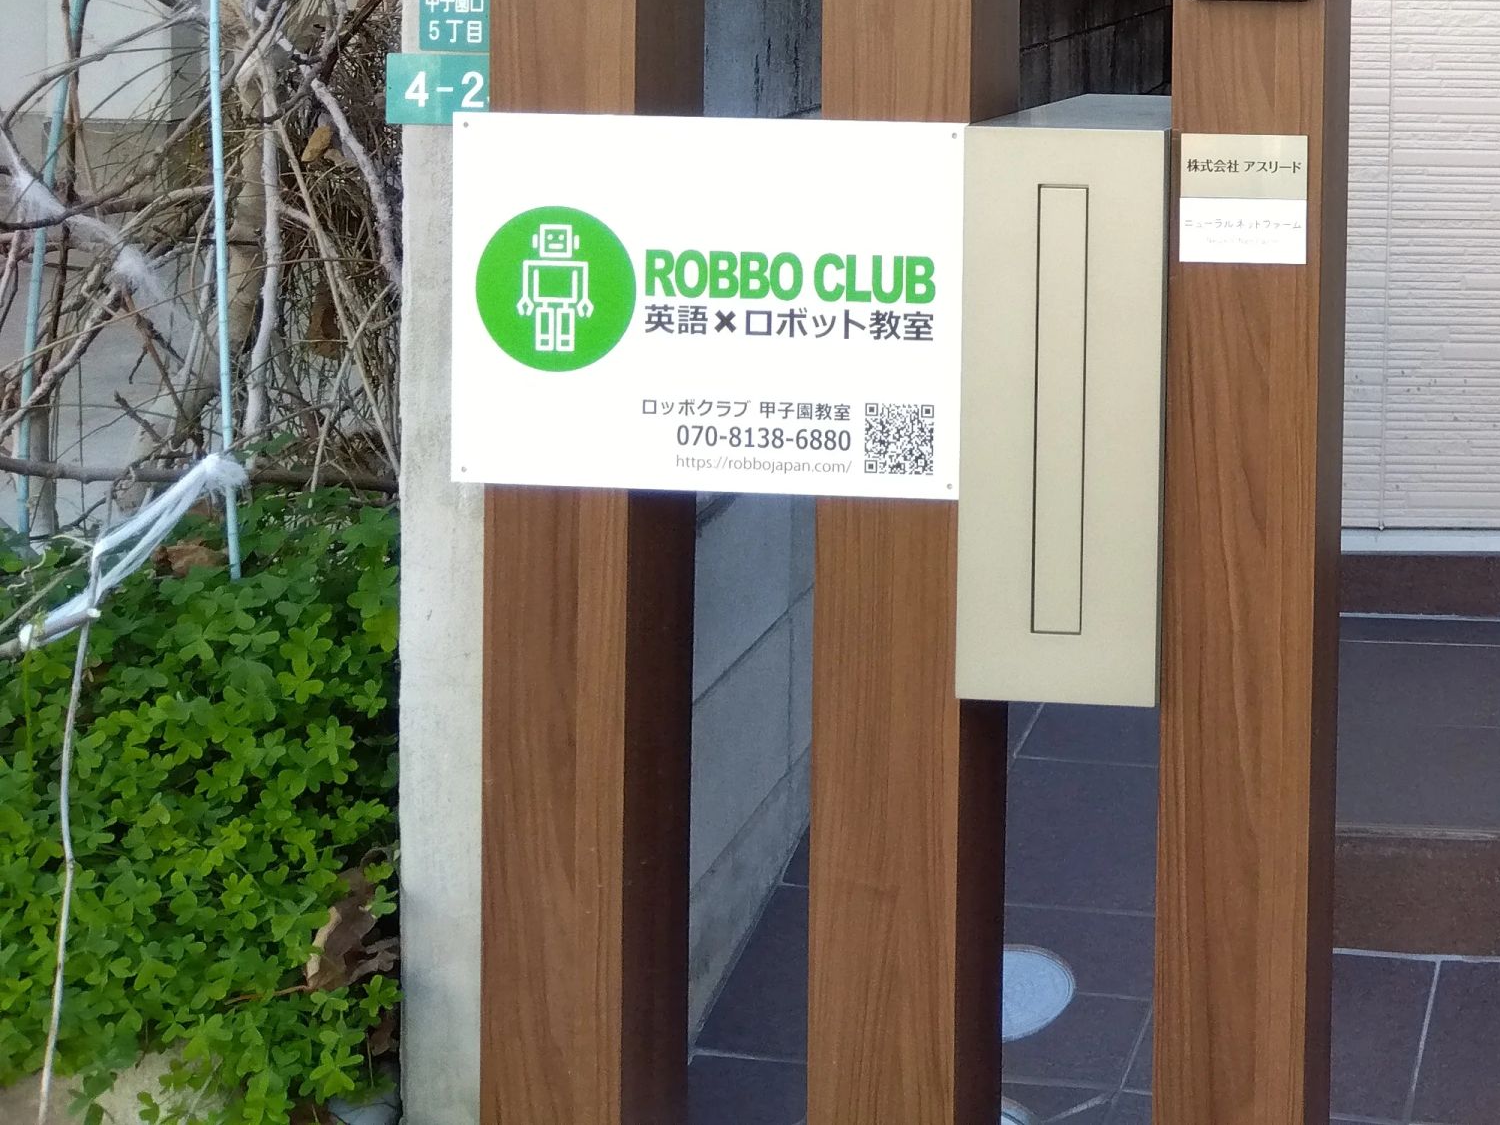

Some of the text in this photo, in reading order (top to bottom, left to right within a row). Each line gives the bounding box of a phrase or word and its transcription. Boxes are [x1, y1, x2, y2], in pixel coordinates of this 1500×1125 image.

[404, 70, 490, 108] 4-2
[1187, 159, 1302, 174] 株式会社 アスリード
[645, 249, 936, 304] ROBBO CLUB
[759, 401, 851, 421] 甲子園教室
[676, 424, 851, 451] 070-8138-6880
[675, 455, 852, 474] https://robbojapan.com/
